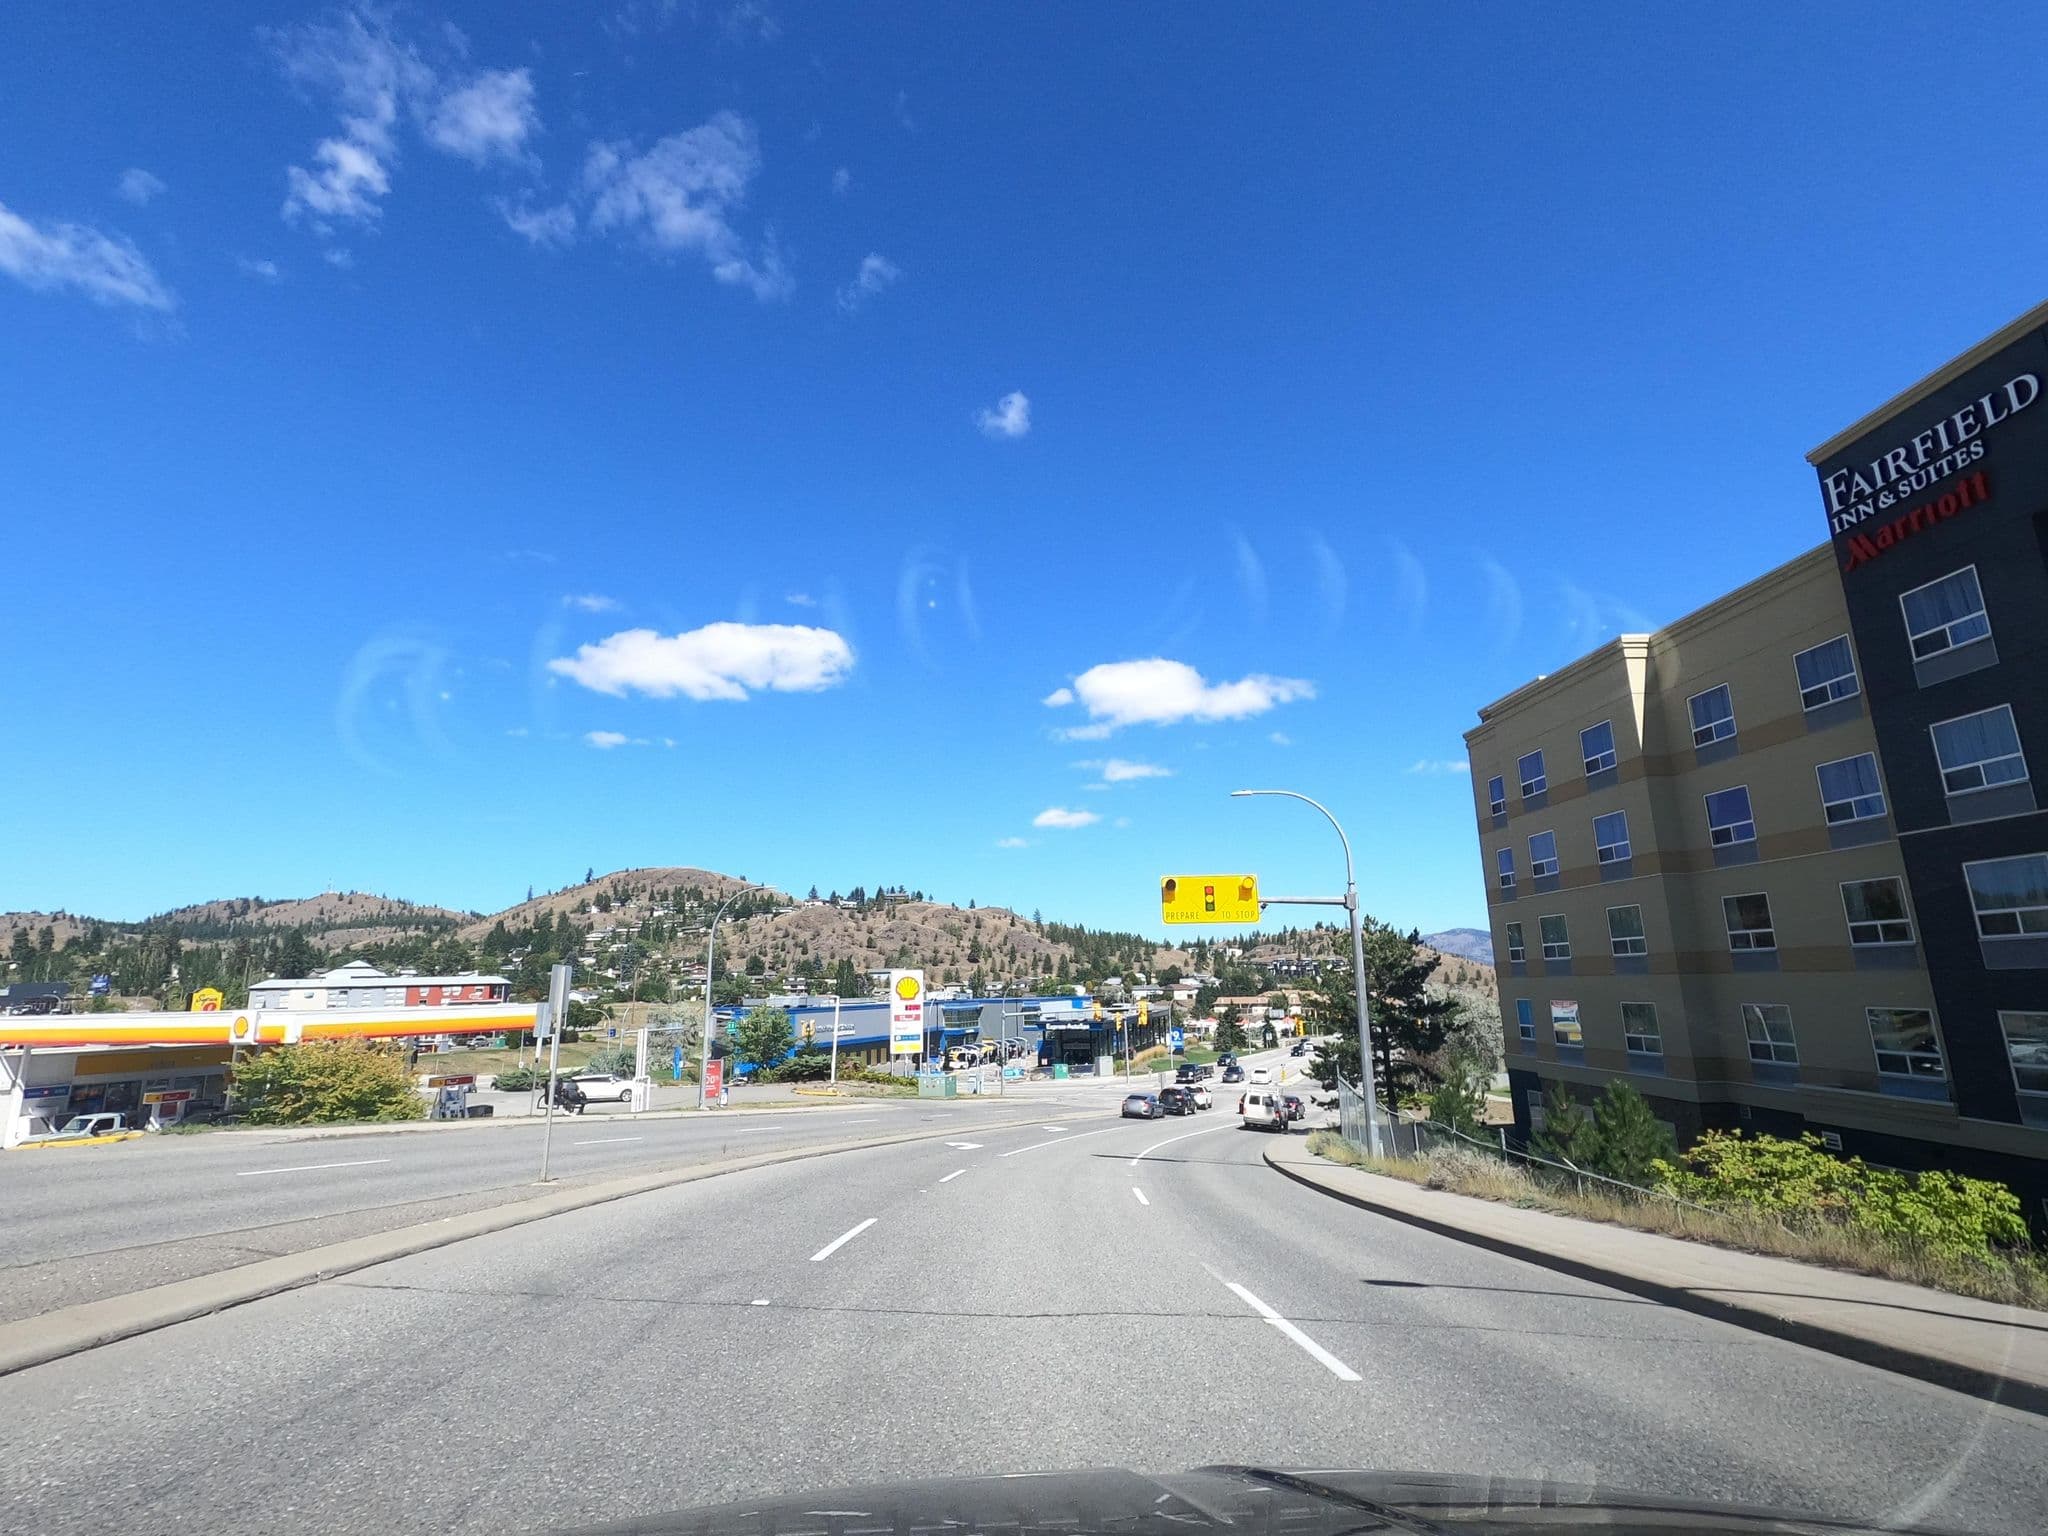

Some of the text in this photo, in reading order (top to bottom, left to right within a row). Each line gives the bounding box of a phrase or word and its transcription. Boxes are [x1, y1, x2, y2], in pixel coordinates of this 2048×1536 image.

[1823, 373, 2040, 514] FAIRFIELD
[1832, 439, 1985, 535] INN & SUITES
[1846, 471, 1992, 572] Marriott
[1165, 911, 1255, 920] PREPARE TO STOP
